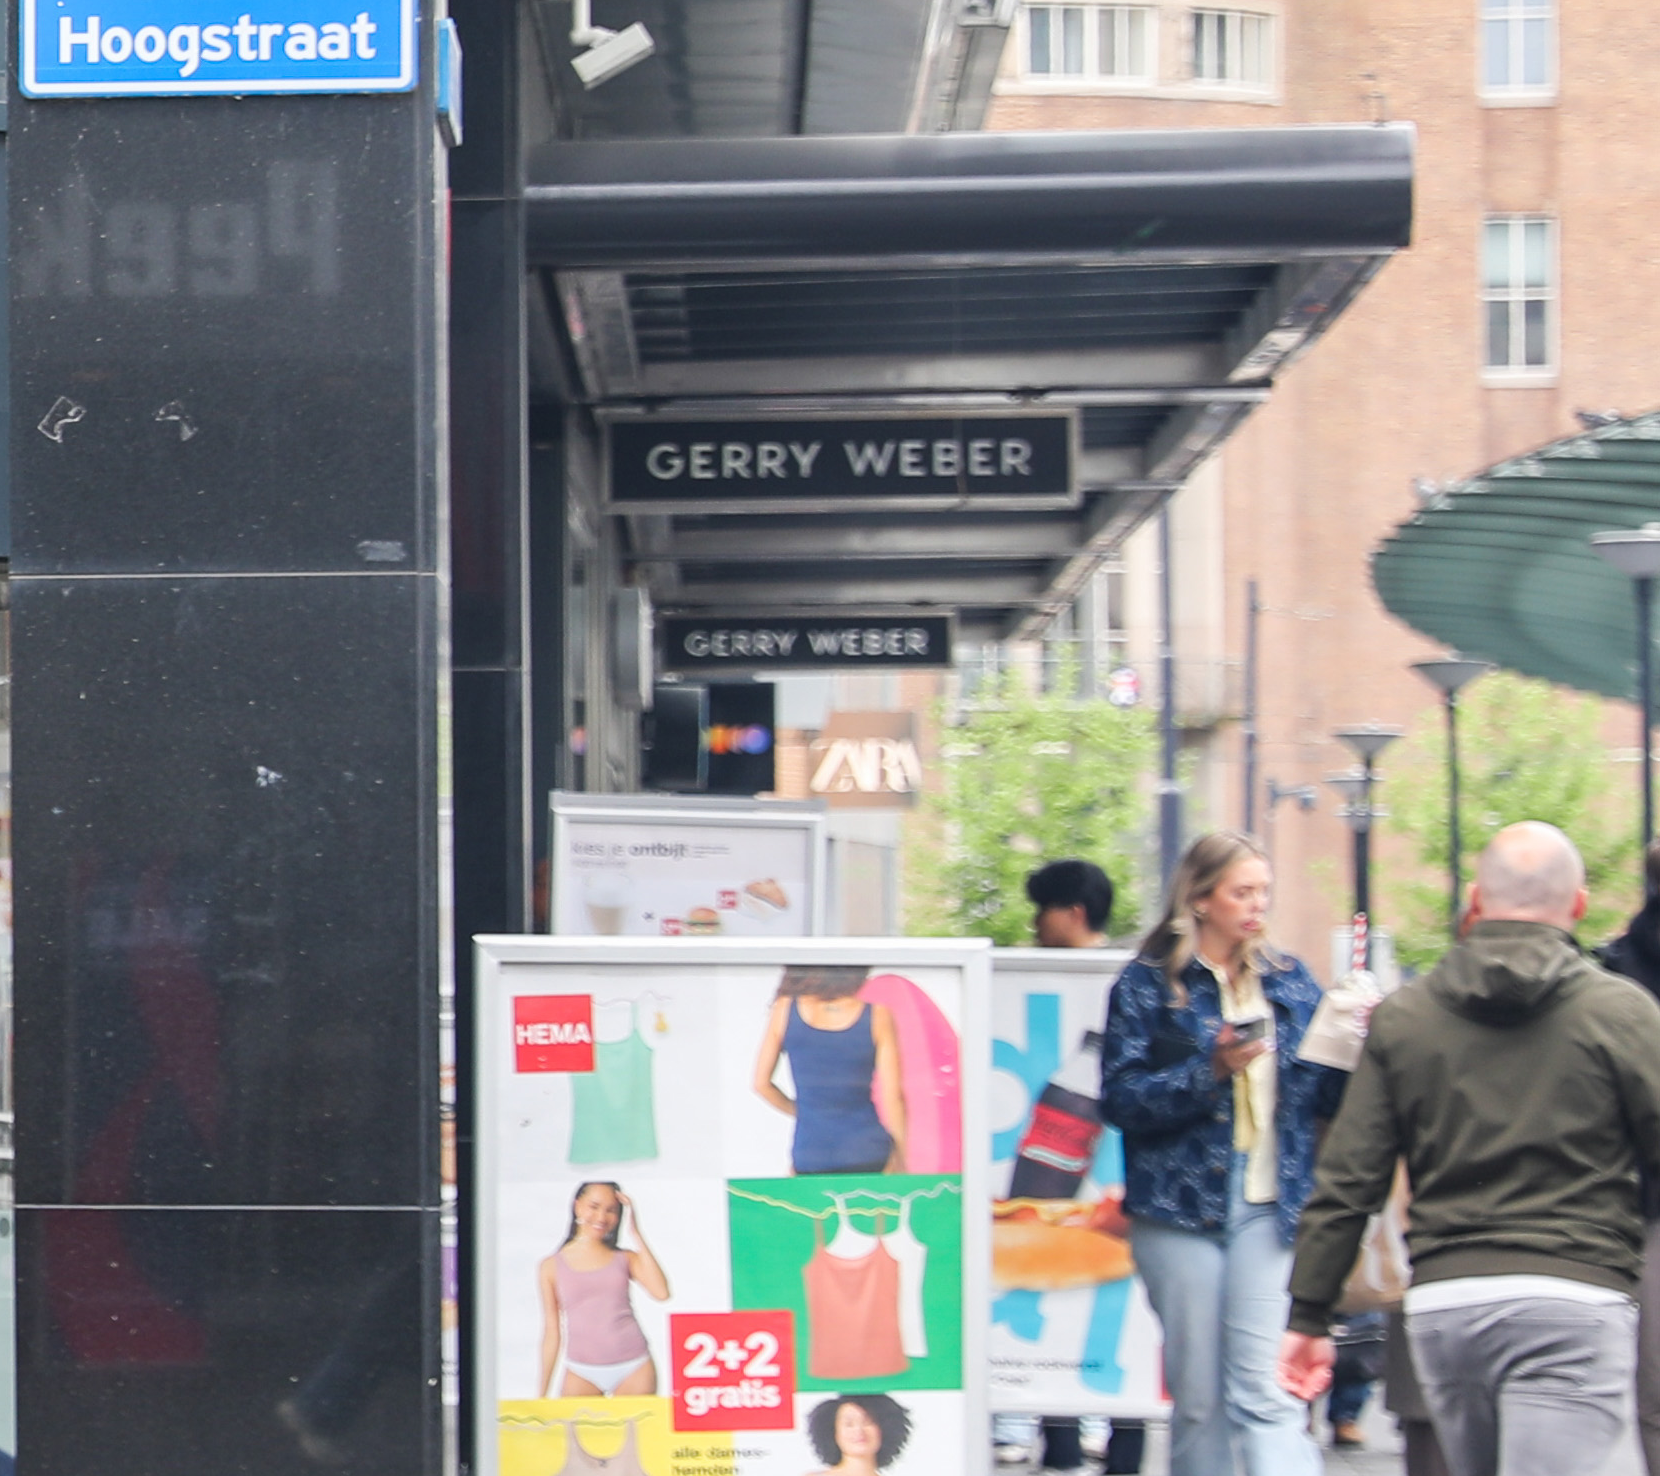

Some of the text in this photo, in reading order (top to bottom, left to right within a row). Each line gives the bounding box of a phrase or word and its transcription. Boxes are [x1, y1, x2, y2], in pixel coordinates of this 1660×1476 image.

[57, 10, 378, 78] Hoogstraat
[645, 437, 1034, 480] GERRY WEBER
[683, 627, 930, 658] GERRY WEBER
[514, 1023, 593, 1046] HEMA
[682, 1331, 781, 1379] 2+2
[683, 1379, 782, 1418] gratis
